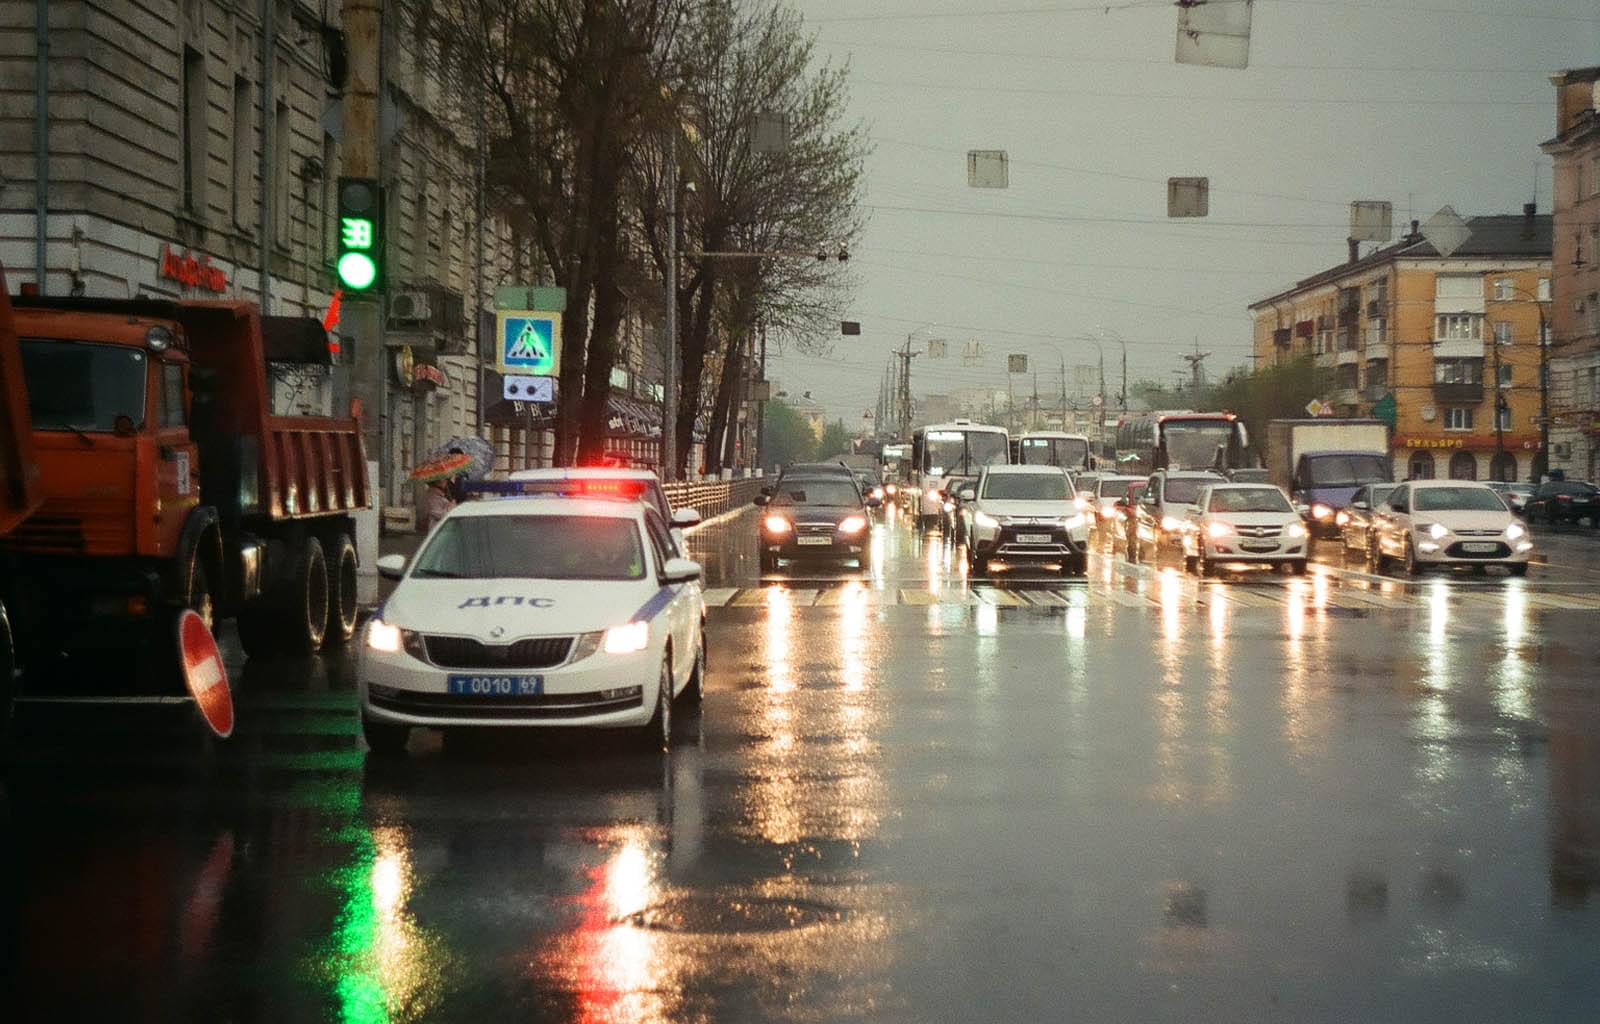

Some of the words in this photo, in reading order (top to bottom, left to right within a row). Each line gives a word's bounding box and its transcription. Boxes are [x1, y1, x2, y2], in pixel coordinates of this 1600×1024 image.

[342, 218, 372, 249] 38
[457, 596, 556, 609] ДПС
[471, 677, 512, 694] 0010
[520, 675, 538, 690] 69
